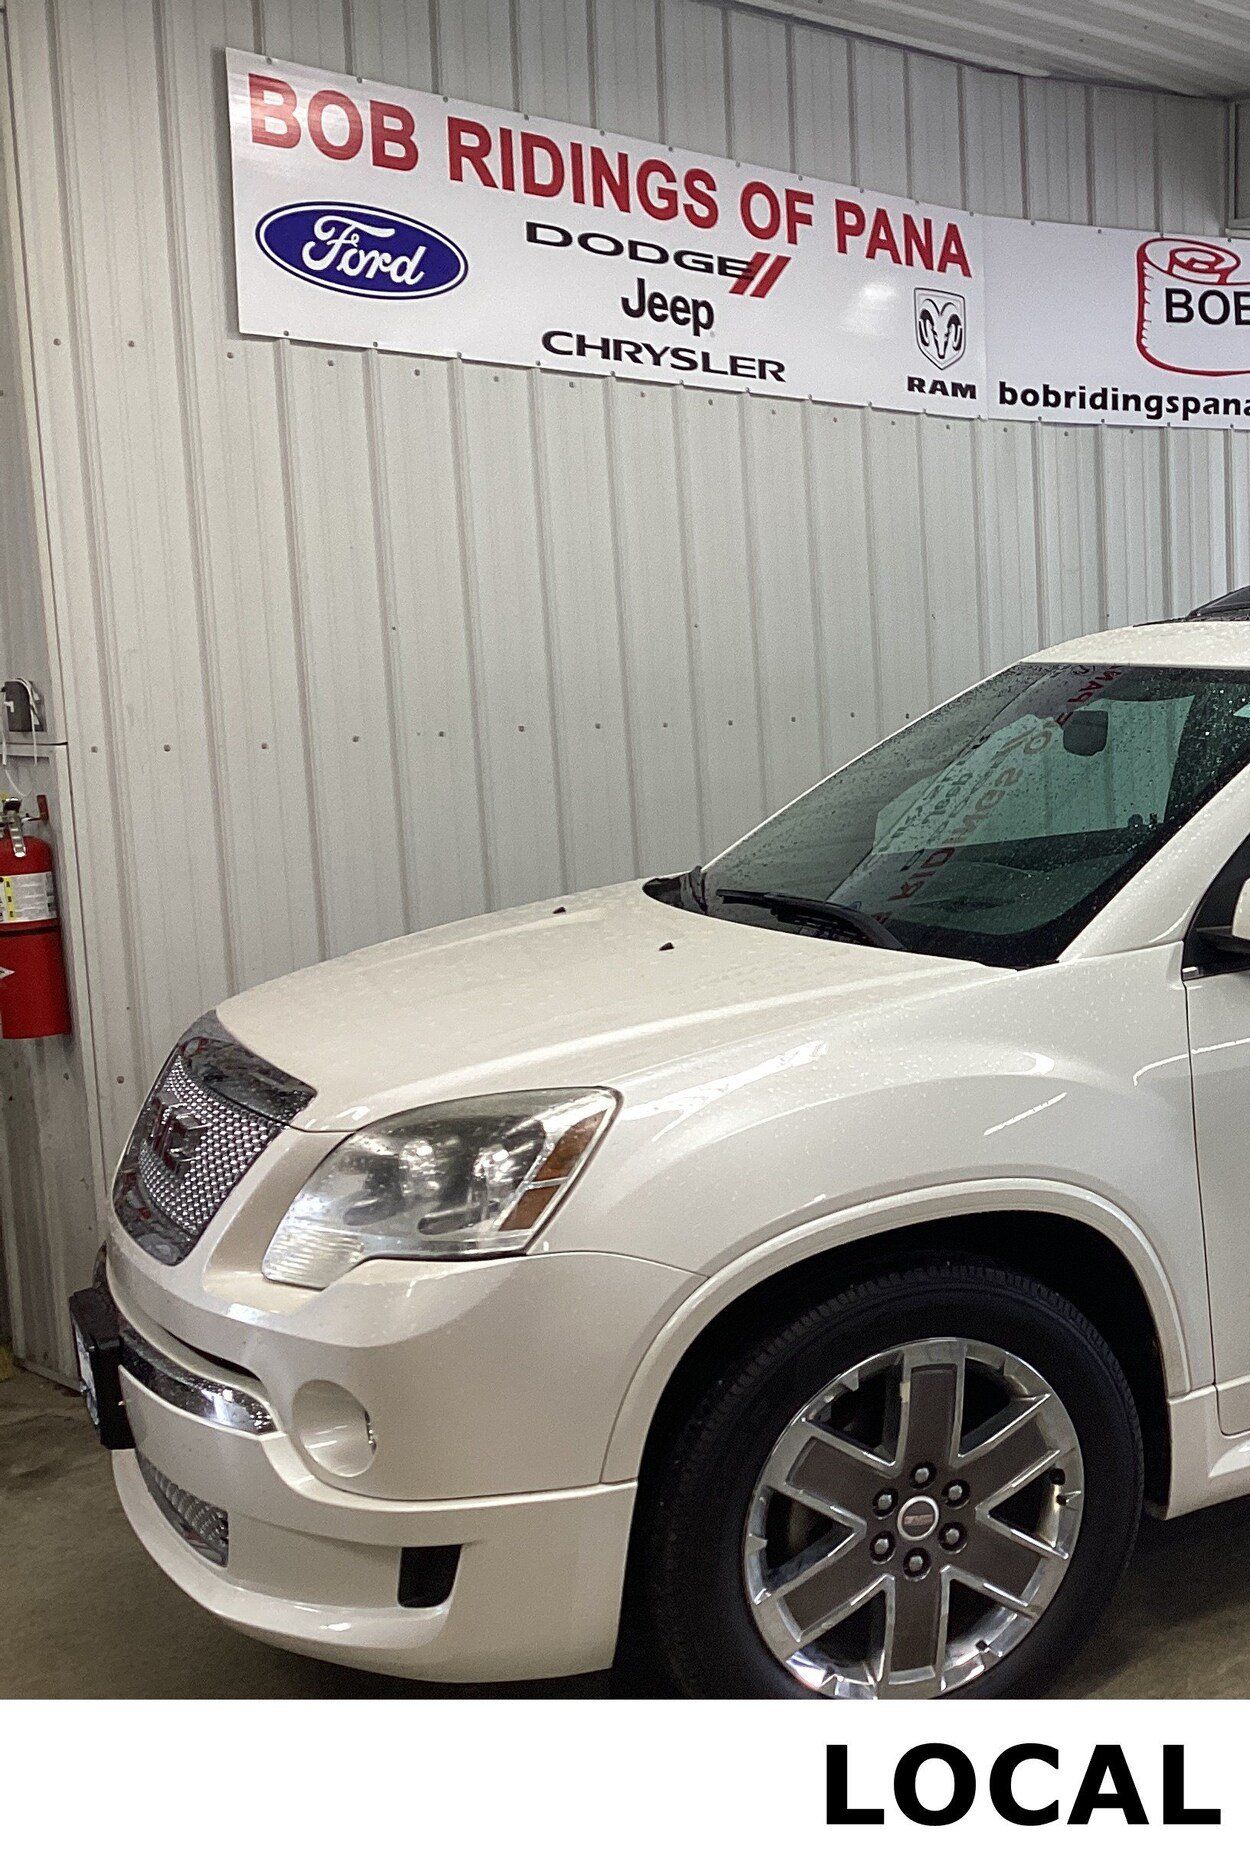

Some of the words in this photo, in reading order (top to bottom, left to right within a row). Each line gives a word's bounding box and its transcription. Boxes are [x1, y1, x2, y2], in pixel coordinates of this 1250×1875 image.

[247, 72, 420, 173] BOB
[447, 116, 720, 230] RIDINGS
[740, 180, 814, 246] OF
[834, 198, 971, 278] PANA
[302, 215, 427, 286] Ford
[525, 221, 756, 280] DODGE
[620, 277, 715, 337] Jeep
[541, 330, 786, 383] CHRYSLER
[907, 376, 977, 400] RAM
